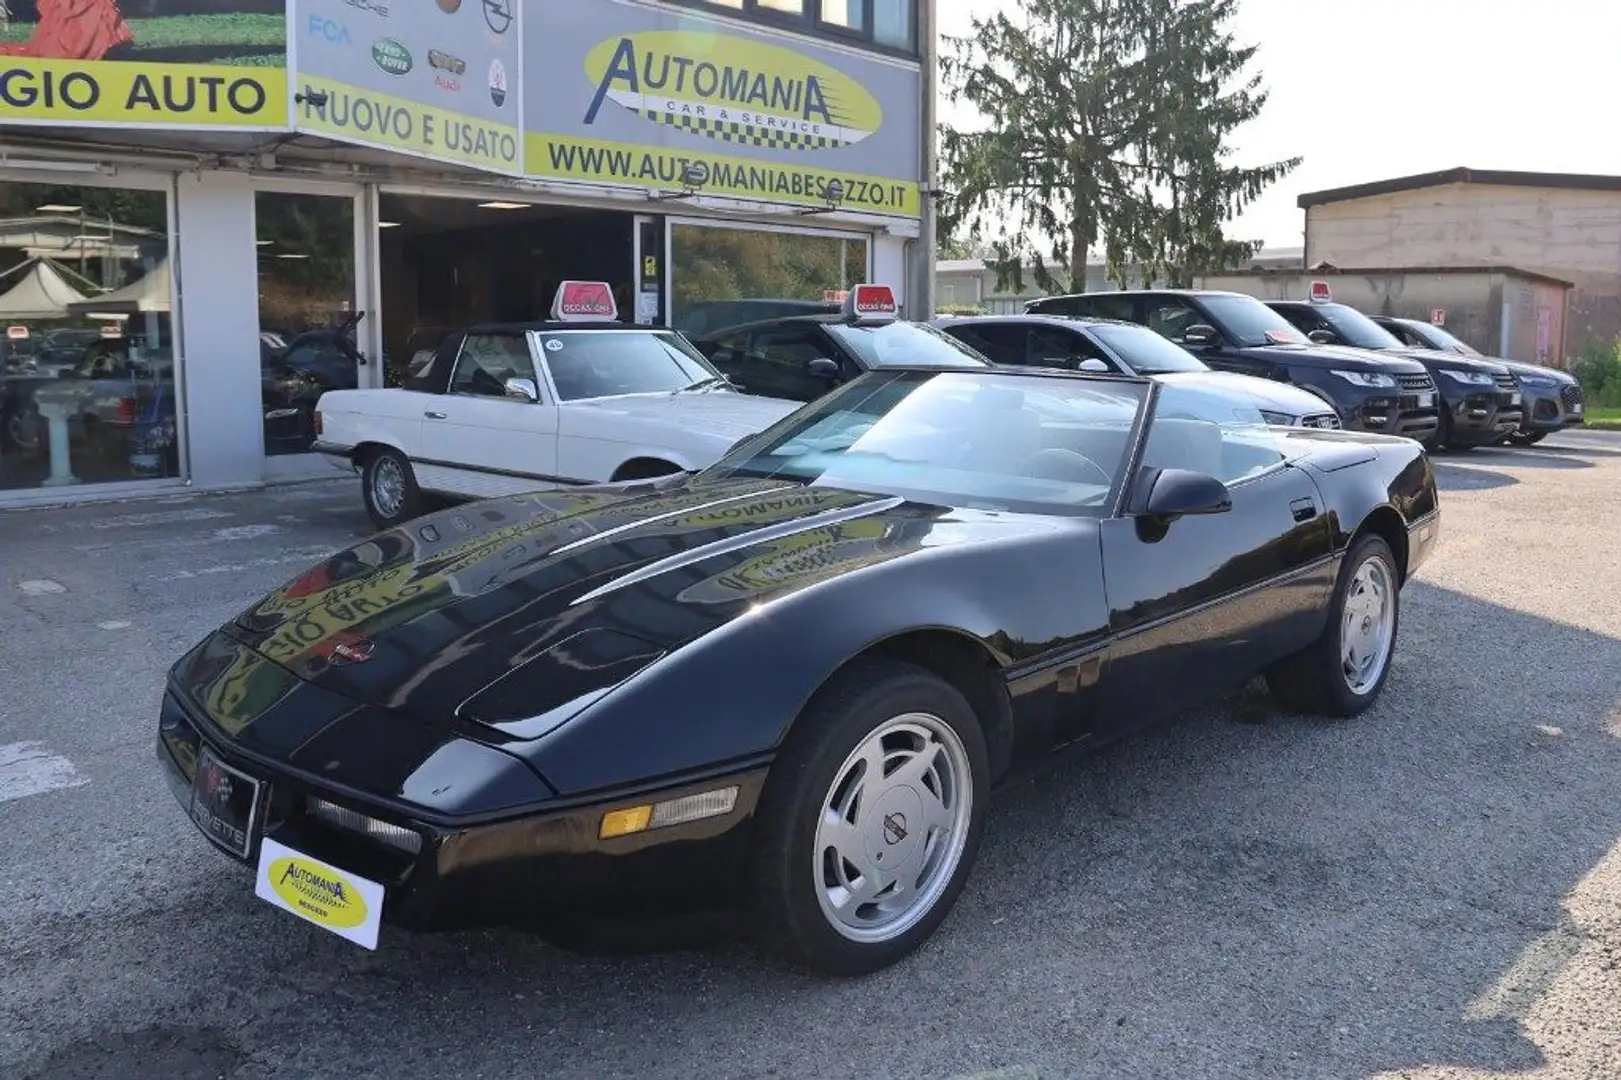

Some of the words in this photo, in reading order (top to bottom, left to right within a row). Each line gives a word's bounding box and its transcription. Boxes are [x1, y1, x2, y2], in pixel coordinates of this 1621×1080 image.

[308, 15, 352, 43] FCA
[0, 69, 100, 110] GIO
[125, 74, 266, 115] AUTO
[583, 37, 833, 125] AUTOMANIA
[305, 84, 413, 140] NUOVO
[422, 114, 434, 146] E
[444, 119, 517, 163] USATO
[666, 100, 706, 117] CAR
[719, 109, 730, 120] &
[742, 112, 822, 134] SERVICE
[193, 803, 246, 849] RVETTE
[280, 862, 345, 900] AUTOMANIA
